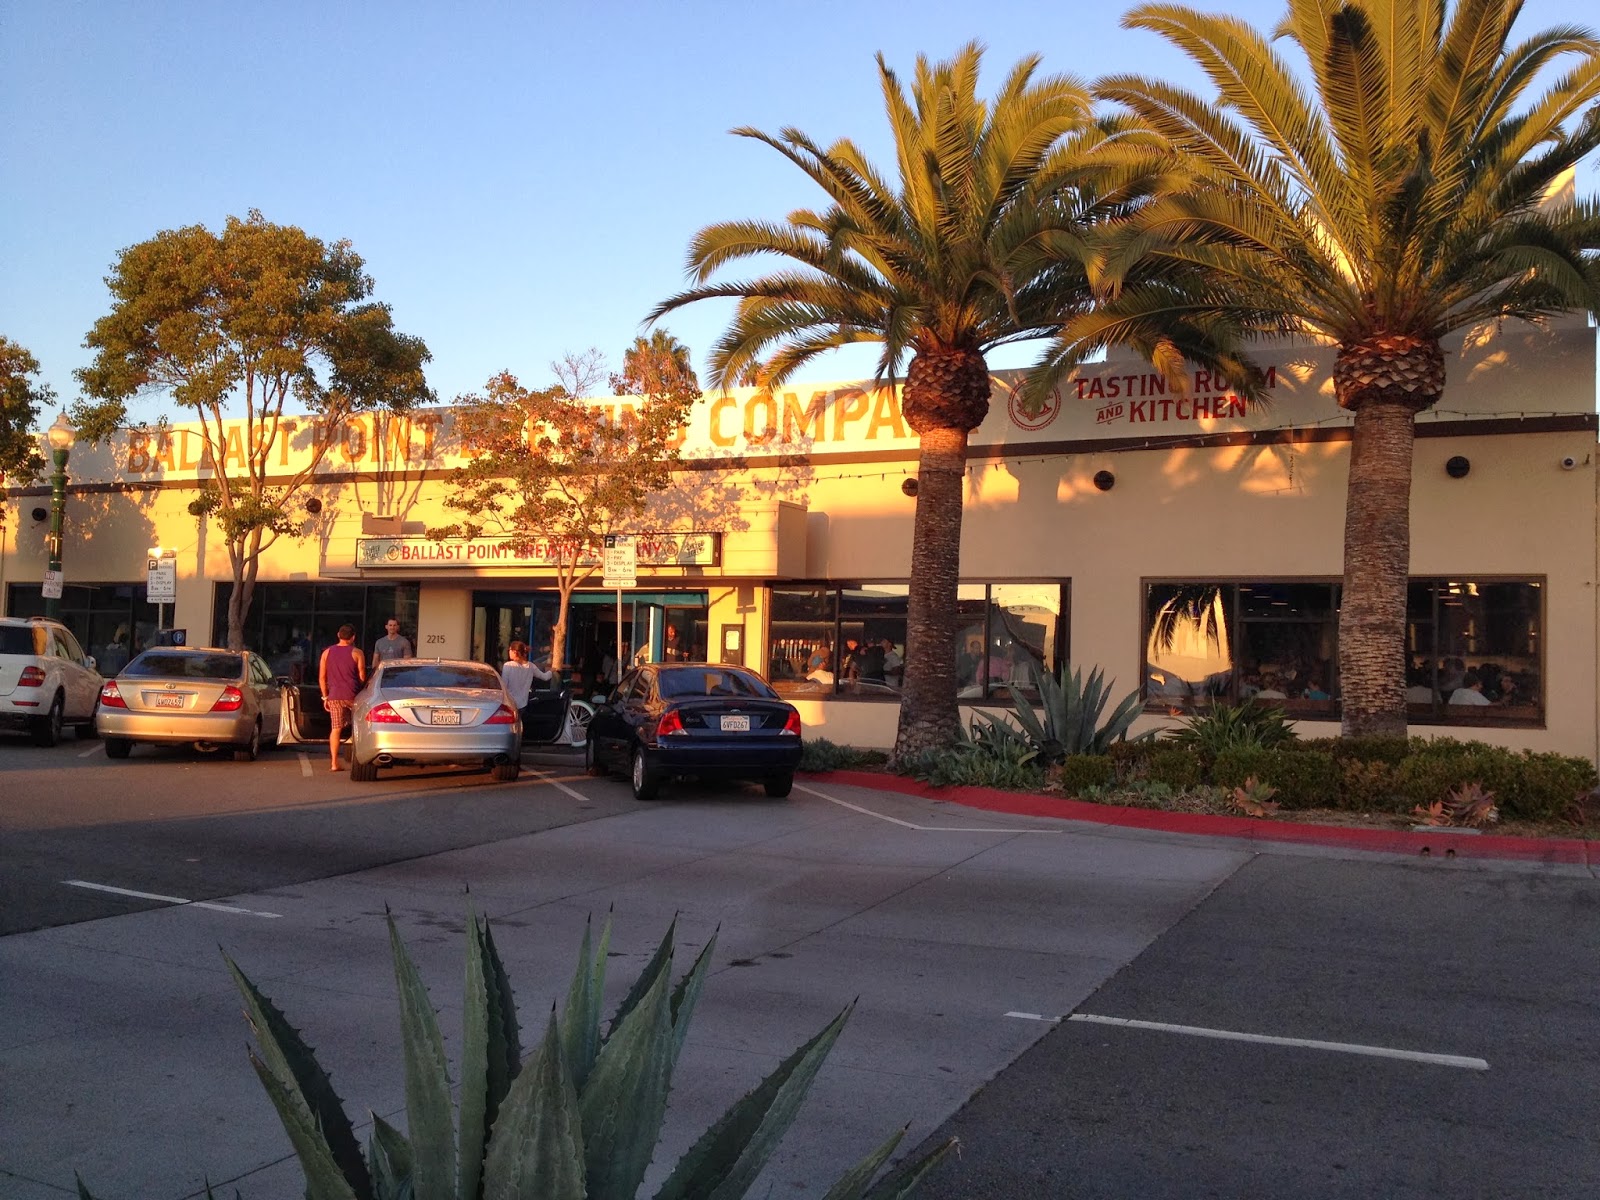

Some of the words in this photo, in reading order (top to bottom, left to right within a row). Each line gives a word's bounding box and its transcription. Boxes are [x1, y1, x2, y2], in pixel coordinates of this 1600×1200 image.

[1194, 366, 1276, 393] ROM
[1096, 405, 1123, 422] AND
[1129, 395, 1246, 423] KITCHEN
[127, 422, 297, 474] BALLAST
[311, 413, 444, 465] POINT
[709, 386, 925, 447] COMPA
[401, 544, 463, 561] BALLAST
[467, 544, 509, 560] POINT
[150, 561, 157, 570] P
[426, 635, 446, 644] 2215
[722, 721, 748, 729] 6VFD267
